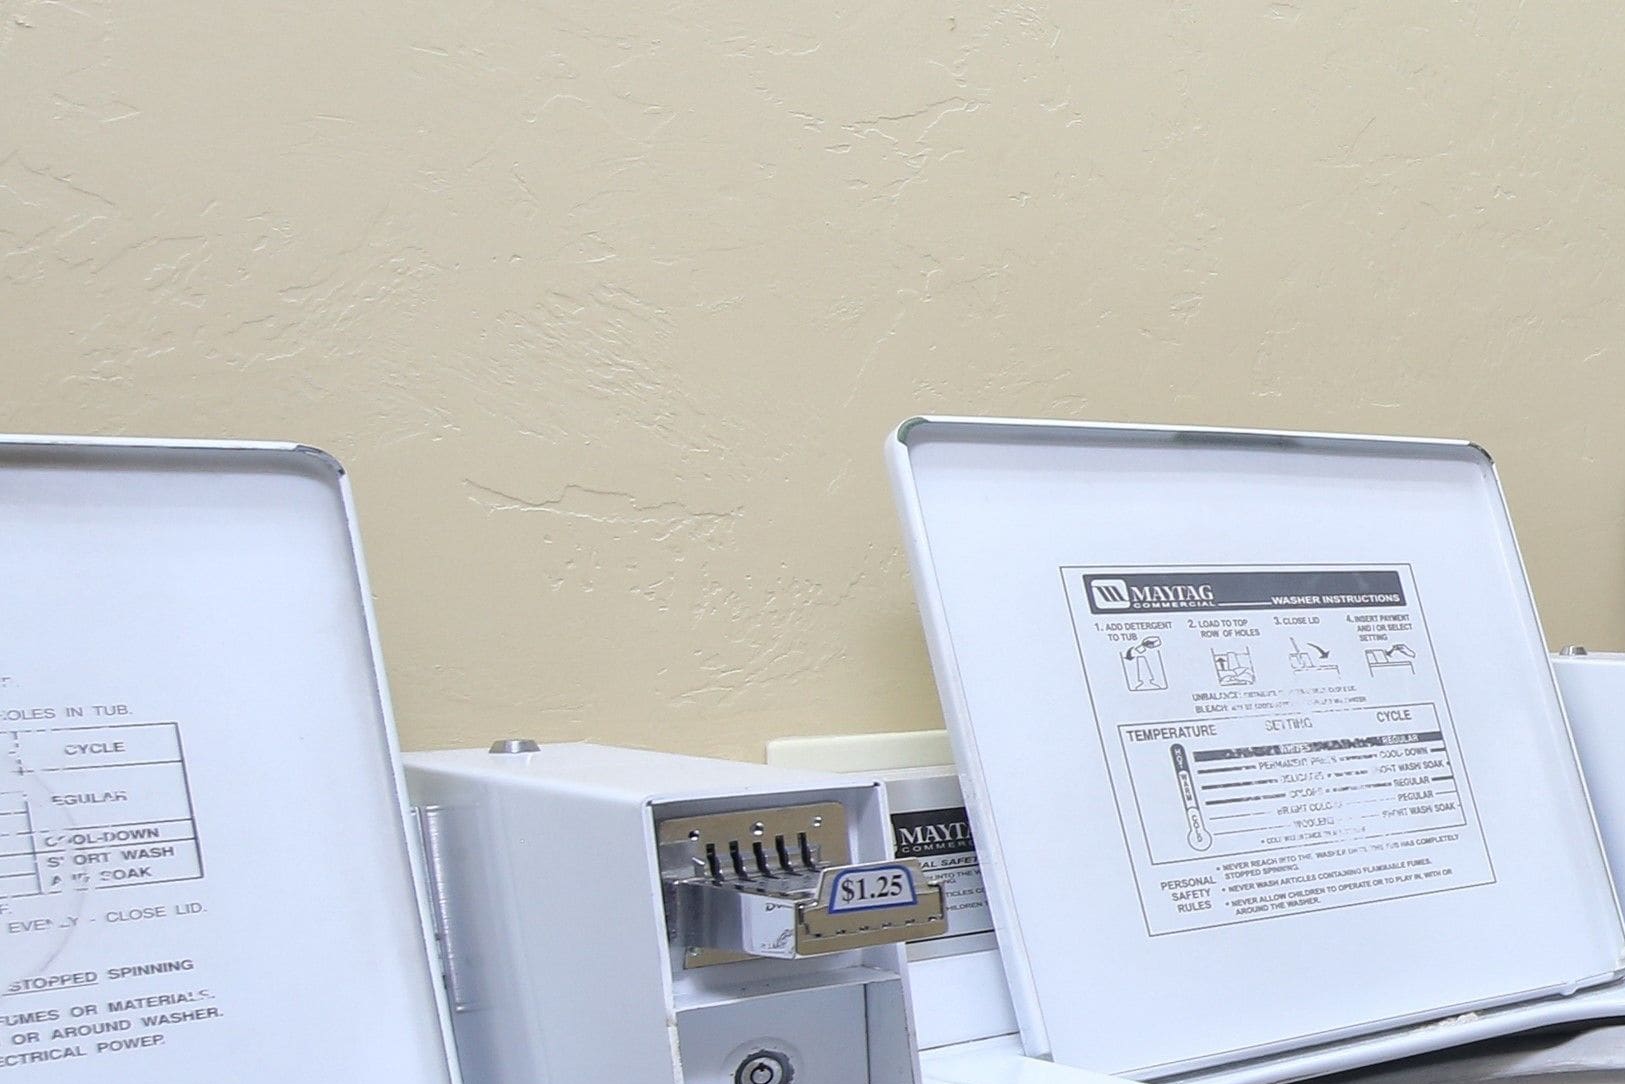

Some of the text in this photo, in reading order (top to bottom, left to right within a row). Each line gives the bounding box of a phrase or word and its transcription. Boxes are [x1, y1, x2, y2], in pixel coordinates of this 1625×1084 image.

[1130, 585, 1214, 601] MAYTAG
[1271, 594, 1400, 605] WASHER INSTRUCTIONS
[1095, 622, 1172, 632] 1. ADD DETERGENT
[1187, 620, 1197, 628] 2.
[1234, 619, 1248, 628] TOP
[1274, 617, 1282, 625] 3.
[1283, 617, 1306, 625] CLOSE
[1201, 630, 1219, 638] ROW
[1234, 628, 1260, 638] HOLES
[66, 707, 83, 717] IN
[92, 704, 133, 716] TUB.
[1376, 710, 1412, 722] CYCLE
[1126, 725, 1217, 742] TEMPERATURE
[1382, 734, 1419, 745] REGULAR
[64, 742, 126, 756] CYCLE
[1398, 762, 1420, 771] WASH
[1423, 760, 1444, 769] SOAK
[1181, 774, 1192, 800] WARM
[1393, 776, 1430, 787] REGULAR
[1409, 805, 1432, 815] WASH
[1434, 802, 1455, 812] SOAK
[1192, 814, 1203, 842] COLD
[46, 846, 174, 868] SORT WASH
[1222, 862, 1249, 871] NEVER
[1251, 858, 1277, 868] REACH
[1416, 834, 1459, 846] COMPLETELY
[1225, 869, 1261, 880] STOPPED
[1228, 883, 1254, 892] NEVER
[1256, 880, 1279, 888] WASH
[1280, 874, 1316, 886] ARTICLES
[1318, 868, 1362, 880] CONTAINING
[1363, 861, 1406, 873] FLAMMABLE
[841, 874, 903, 904] $1.25
[1160, 876, 1217, 890] PERSONAL
[1231, 898, 1258, 907] NEVER
[1260, 894, 1286, 903] ALLOW
[1288, 888, 1326, 898] CHILDREN
[1338, 881, 1371, 891] OPERATE
[1372, 879, 1384, 887] OR
[1395, 874, 1413, 882] PLAY
[1425, 871, 1441, 879] WITH
[1172, 888, 1211, 901] SAFETY
[106, 902, 208, 923] CLOSE LID.
[1177, 900, 1212, 913] RULES
[1236, 905, 1268, 915] AROUND
[8, 959, 195, 992] STOPPED SPINNING
[70, 1004, 98, 1018] OR
[11, 1007, 224, 1046] OR AROUND WASHER.
